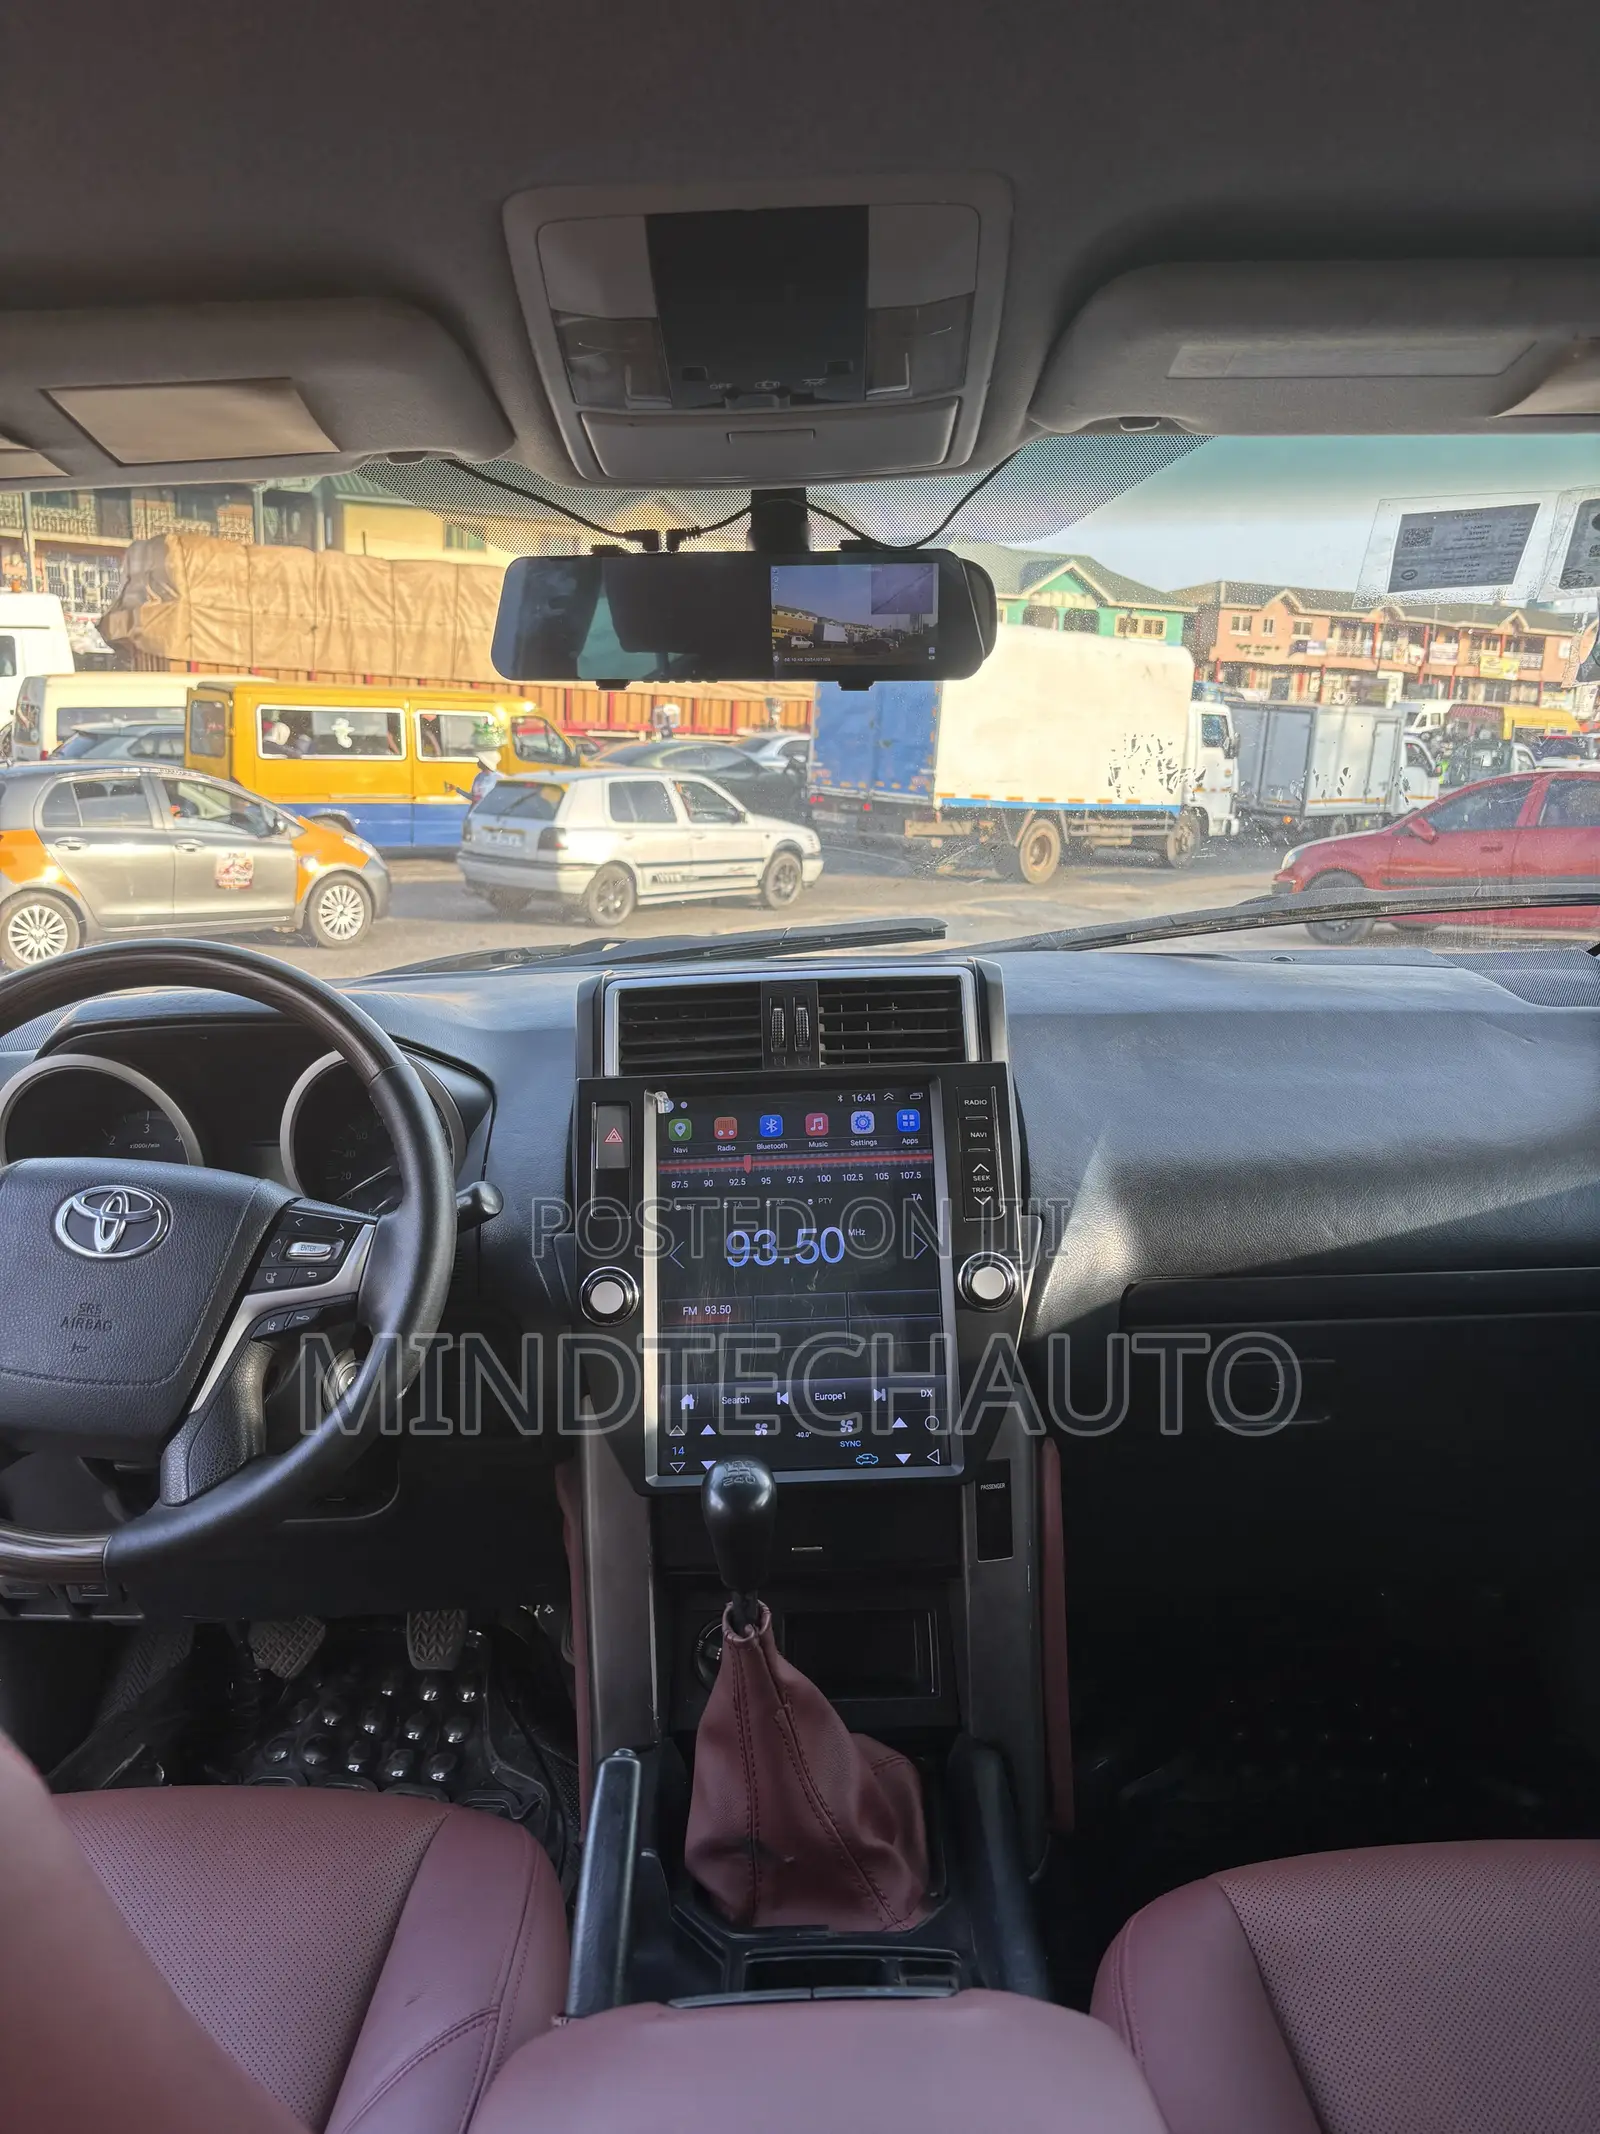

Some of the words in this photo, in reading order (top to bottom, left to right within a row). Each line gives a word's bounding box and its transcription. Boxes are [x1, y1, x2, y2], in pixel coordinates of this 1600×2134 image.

[851, 1093, 876, 1102] 16:41
[143, 1123, 150, 1134] 3
[109, 1135, 116, 1146] 2
[756, 1142, 788, 1150] Bluetooth
[808, 1140, 829, 1148] Music
[850, 1139, 878, 1147] Settings
[901, 1137, 919, 1145] Apps
[340, 1171, 352, 1180] 20
[671, 1180, 689, 1189] 87.5
[703, 1179, 714, 1187] 90
[729, 1178, 746, 1187] 92.5
[760, 1177, 772, 1185] 95
[786, 1176, 804, 1184] 97.5
[817, 1174, 832, 1183] 100
[842, 1173, 864, 1182] 102.5
[875, 1172, 890, 1181] 105
[900, 1171, 922, 1180] 107.5
[911, 1193, 922, 1201] TA
[300, 1244, 317, 1252] ENTER
[726, 1226, 845, 1268] 93.50
[848, 1228, 866, 1236] MHz
[682, 1306, 698, 1316] FM
[704, 1304, 732, 1315] 93.50
[60, 1315, 113, 1332] AIRBAG
[721, 1395, 750, 1405] Search
[814, 1391, 846, 1402] Europe1
[920, 1389, 933, 1398] DX
[839, 1440, 862, 1448] SYNC
[671, 1446, 686, 1456] 14
[980, 1482, 1006, 1490] PASSENGER
